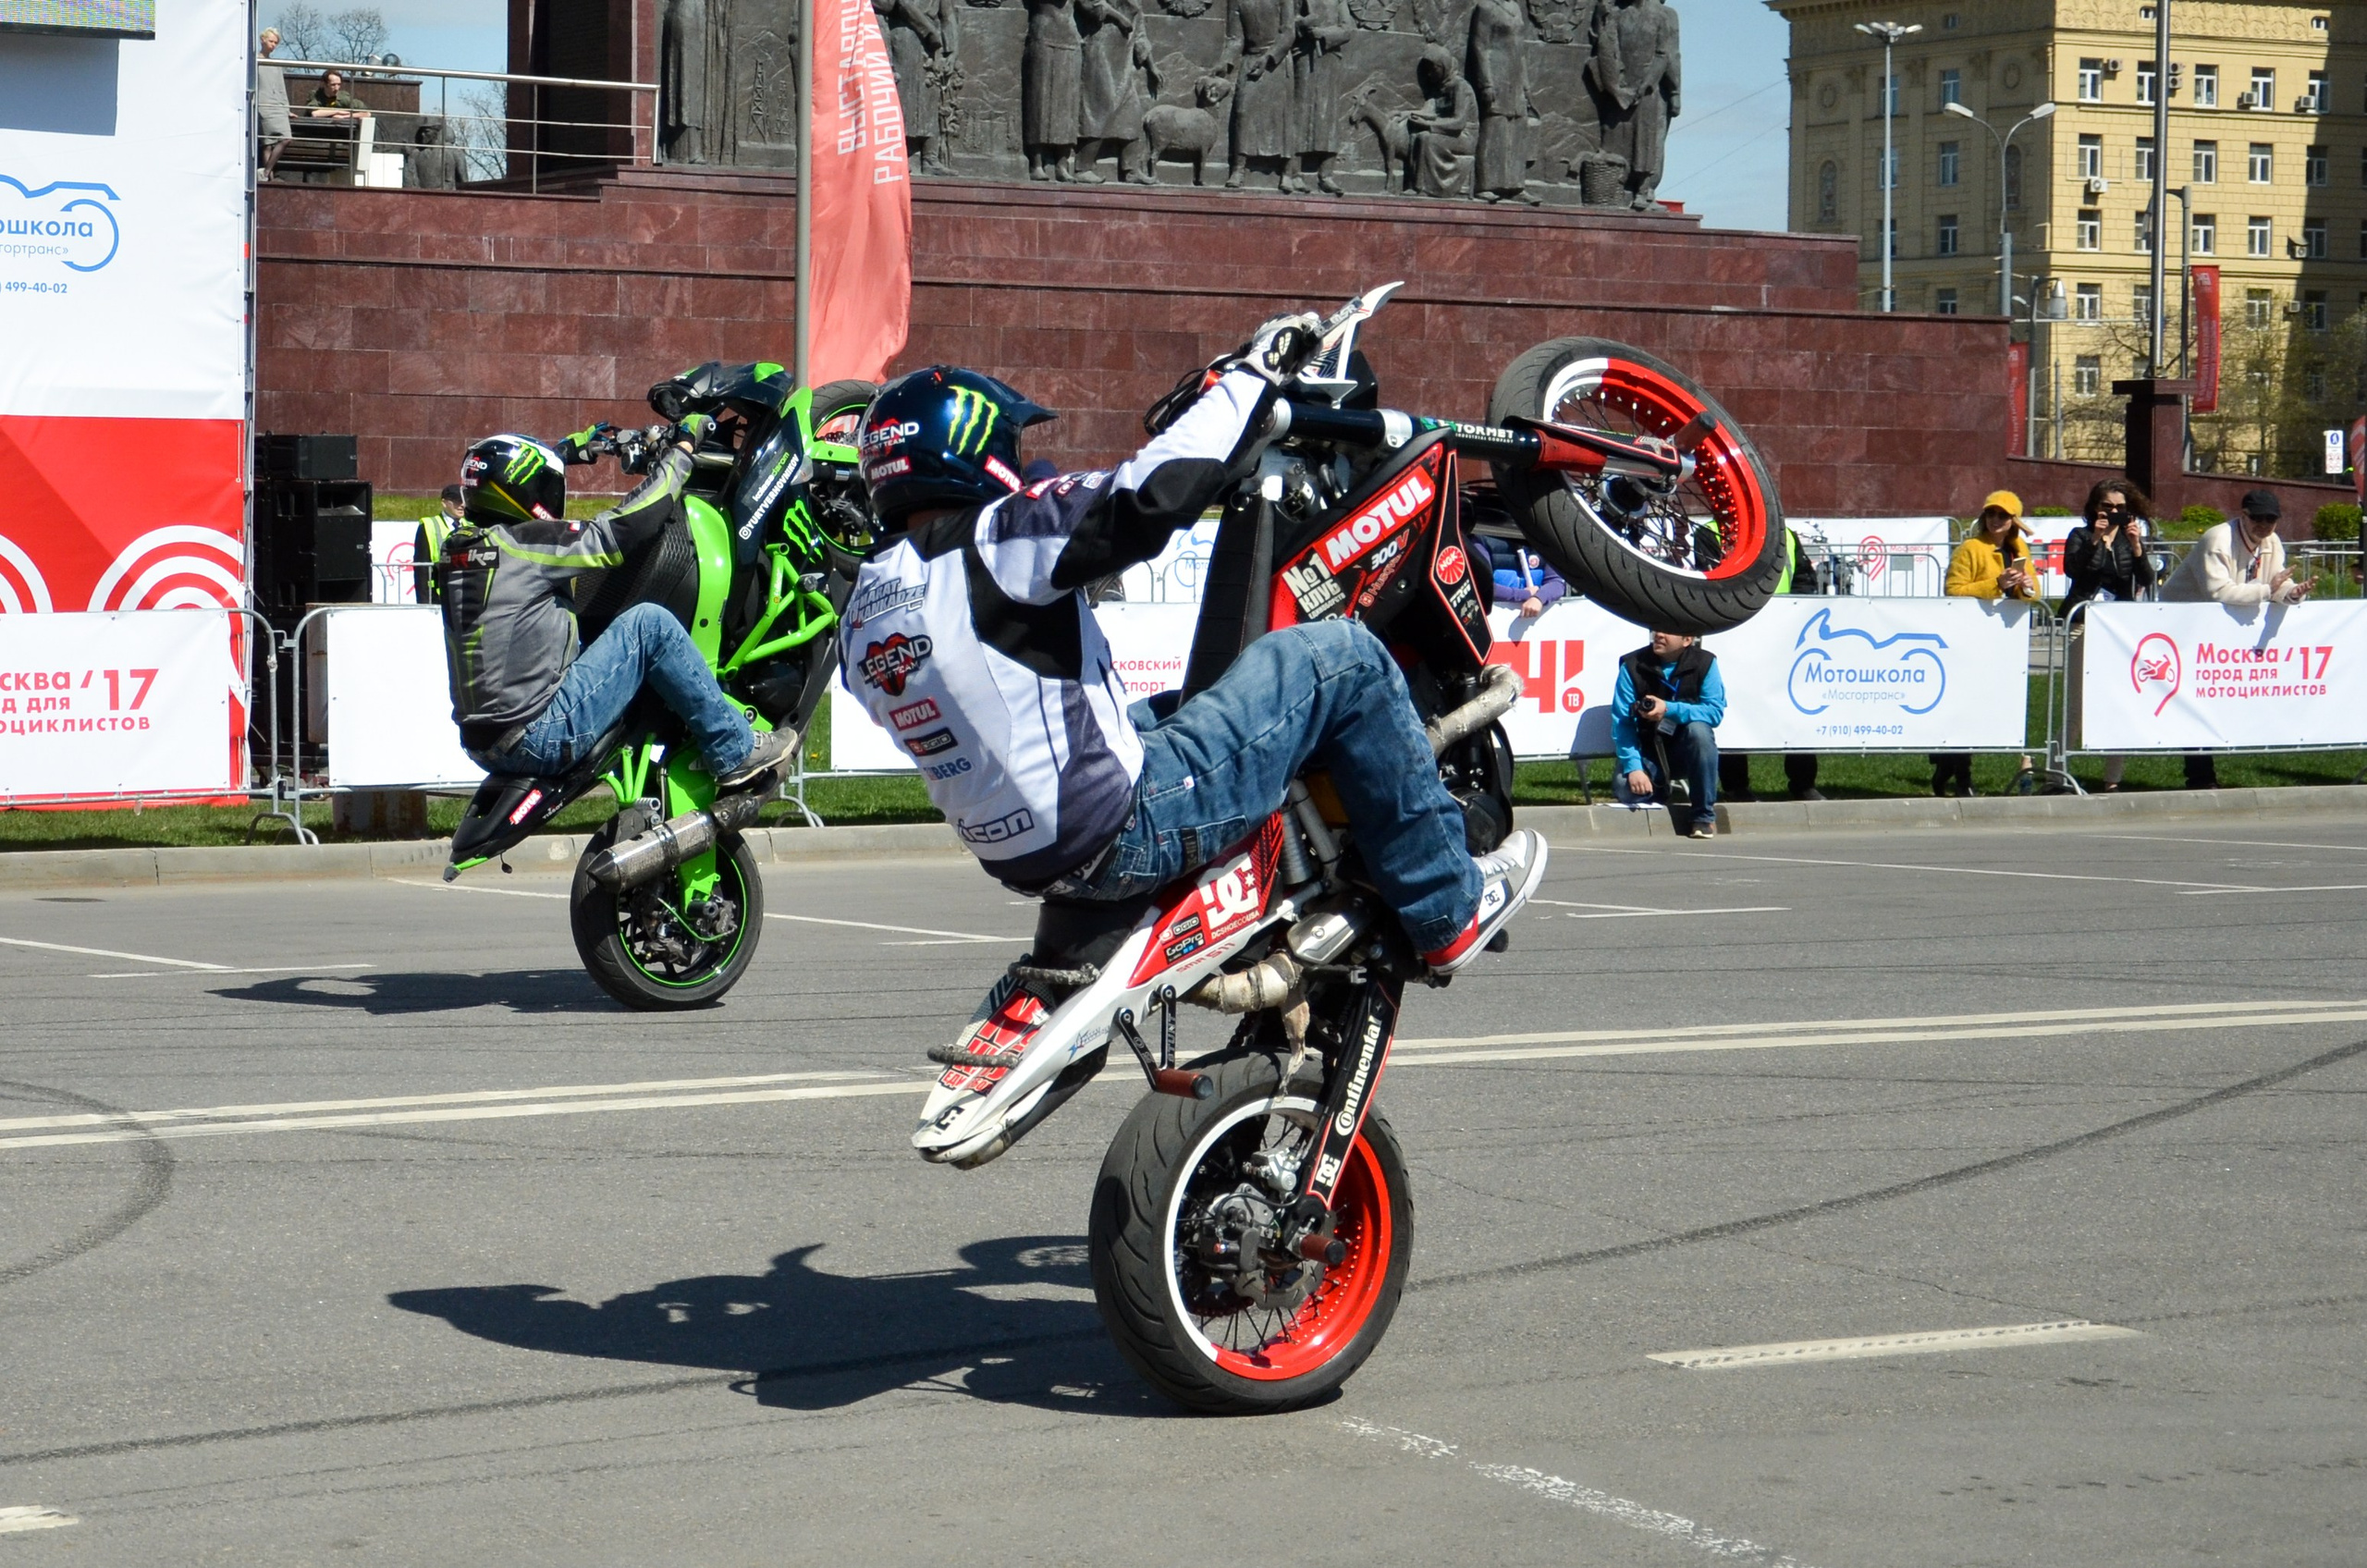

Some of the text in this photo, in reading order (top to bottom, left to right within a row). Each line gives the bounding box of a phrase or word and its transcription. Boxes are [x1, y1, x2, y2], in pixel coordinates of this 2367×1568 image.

[5, 281, 67, 294] 499-40-02
[1456, 423, 1515, 439] TORMET
[871, 459, 909, 480] MOTUL
[1325, 476, 1432, 568] MOTUL
[1371, 528, 1410, 570] 300V
[1439, 550, 1458, 571] NGK
[1297, 578, 1342, 614] КЛУБ
[859, 637, 931, 681] LEGEND
[2196, 643, 2278, 664] Москва
[1805, 662, 1925, 683] Мотошкола
[2196, 668, 2277, 684] город для
[1821, 689, 1906, 703] «Мосгортранс»
[2196, 684, 2326, 699] мотоциклистов
[27, 697, 70, 713] для
[894, 703, 937, 728] MOTUL
[1816, 725, 1903, 737] +7 (910) 499-40-02
[1172, 915, 1200, 937] OGIO
[1165, 931, 1204, 957] GoPro
[1335, 1015, 1382, 1136] Continental
